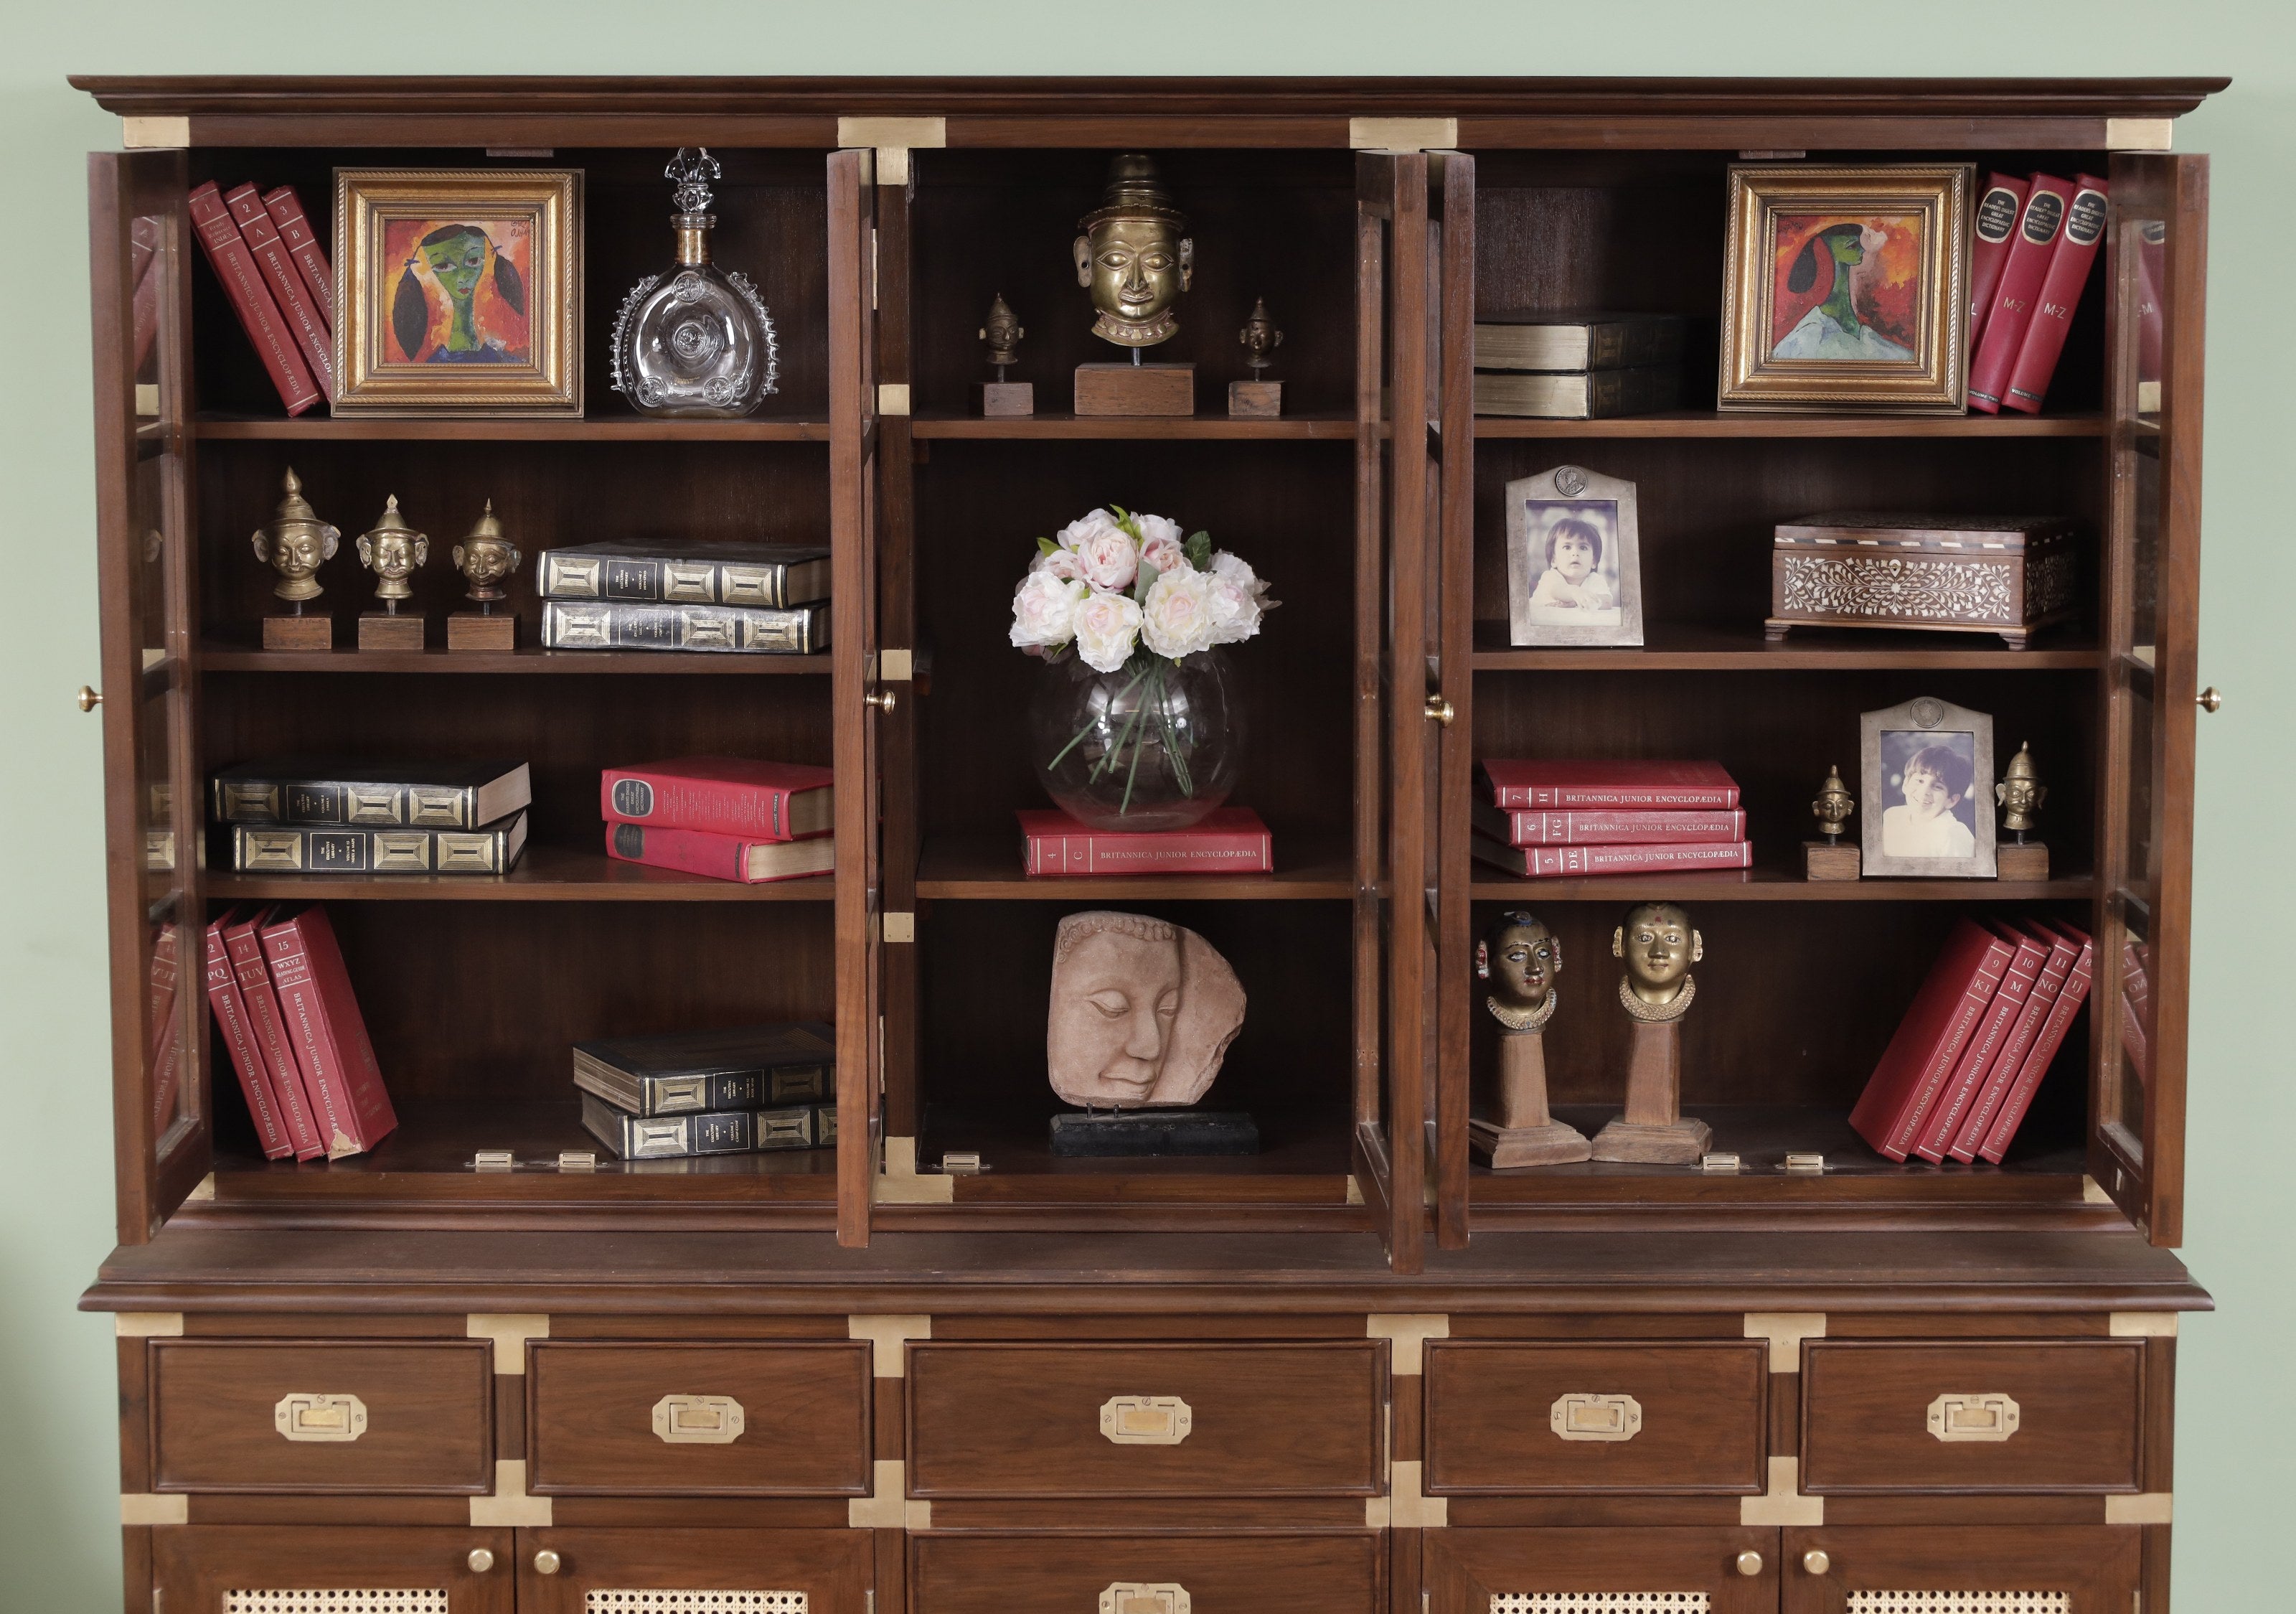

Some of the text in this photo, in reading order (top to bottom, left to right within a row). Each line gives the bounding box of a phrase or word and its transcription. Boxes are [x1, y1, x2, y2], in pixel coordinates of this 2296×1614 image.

[243, 204, 251, 213] 2
[280, 205, 287, 215] 3
[255, 228, 264, 238] A
[1982, 222, 2005, 232] DICTIONARY
[291, 230, 300, 240] B
[304, 254, 332, 303] BRITANNICA
[227, 252, 255, 301] BRITANNICA
[250, 301, 270, 332] JUNIOR
[2003, 296, 2026, 313] M-Z
[267, 251, 331, 379] BRITANNICA JUNIOR ENCYCLO
[2044, 303, 2066, 319] M-Z
[1969, 390, 1987, 399] VOLUME
[2011, 388, 2031, 398] VOLUME
[1538, 792, 1548, 802] H
[1566, 794, 1619, 803] BRITANNICA
[1619, 794, 1652, 804] JUNIOR
[1579, 823, 1630, 832] BRITANNICA
[1630, 823, 1663, 832] JUNIOR
[1074, 850, 1083, 861] C
[1100, 851, 1152, 860] BRITANNICA
[1154, 851, 1187, 860] JUNIOR
[1569, 850, 1578, 870] DE
[1594, 854, 1643, 863] BRITANNICA
[1645, 853, 1675, 863] JUNIOR
[238, 944, 250, 954] 14
[278, 940, 289, 952] 15
[277, 957, 301, 969] WXYZ
[1992, 960, 2000, 969] 9
[2022, 957, 2035, 969] 10
[2055, 957, 2068, 969] 11
[2085, 958, 2092, 967] 8
[207, 968, 228, 982] PQ
[238, 966, 264, 982] TUV
[283, 975, 303, 985] ATLAS
[1974, 979, 1992, 995] KL
[2010, 981, 2023, 993] M
[2038, 977, 2058, 993] NO
[2071, 980, 2083, 993] IJ
[1947, 1006, 1975, 1054] BRITANNICA
[1980, 1005, 2009, 1055] BRITANNICA
[2012, 1005, 2041, 1054] BRITANNICA
[2041, 1005, 2069, 1052] BRITANNICA
[222, 995, 244, 1045] BRITANNICA
[237, 1046, 255, 1078] JUNIOR
[256, 995, 277, 1045] BRITANNICA
[270, 1047, 288, 1078] JUNIOR
[293, 993, 339, 1132] BRITANNICA JUNIOR ENCYCLOPÆ
[1930, 1052, 1950, 1084] JUNIOR
[1996, 1052, 2015, 1084] JUNIOR
[2025, 1052, 2045, 1084] JUNIOR
[1965, 1054, 1987, 1085] JUNIOR
